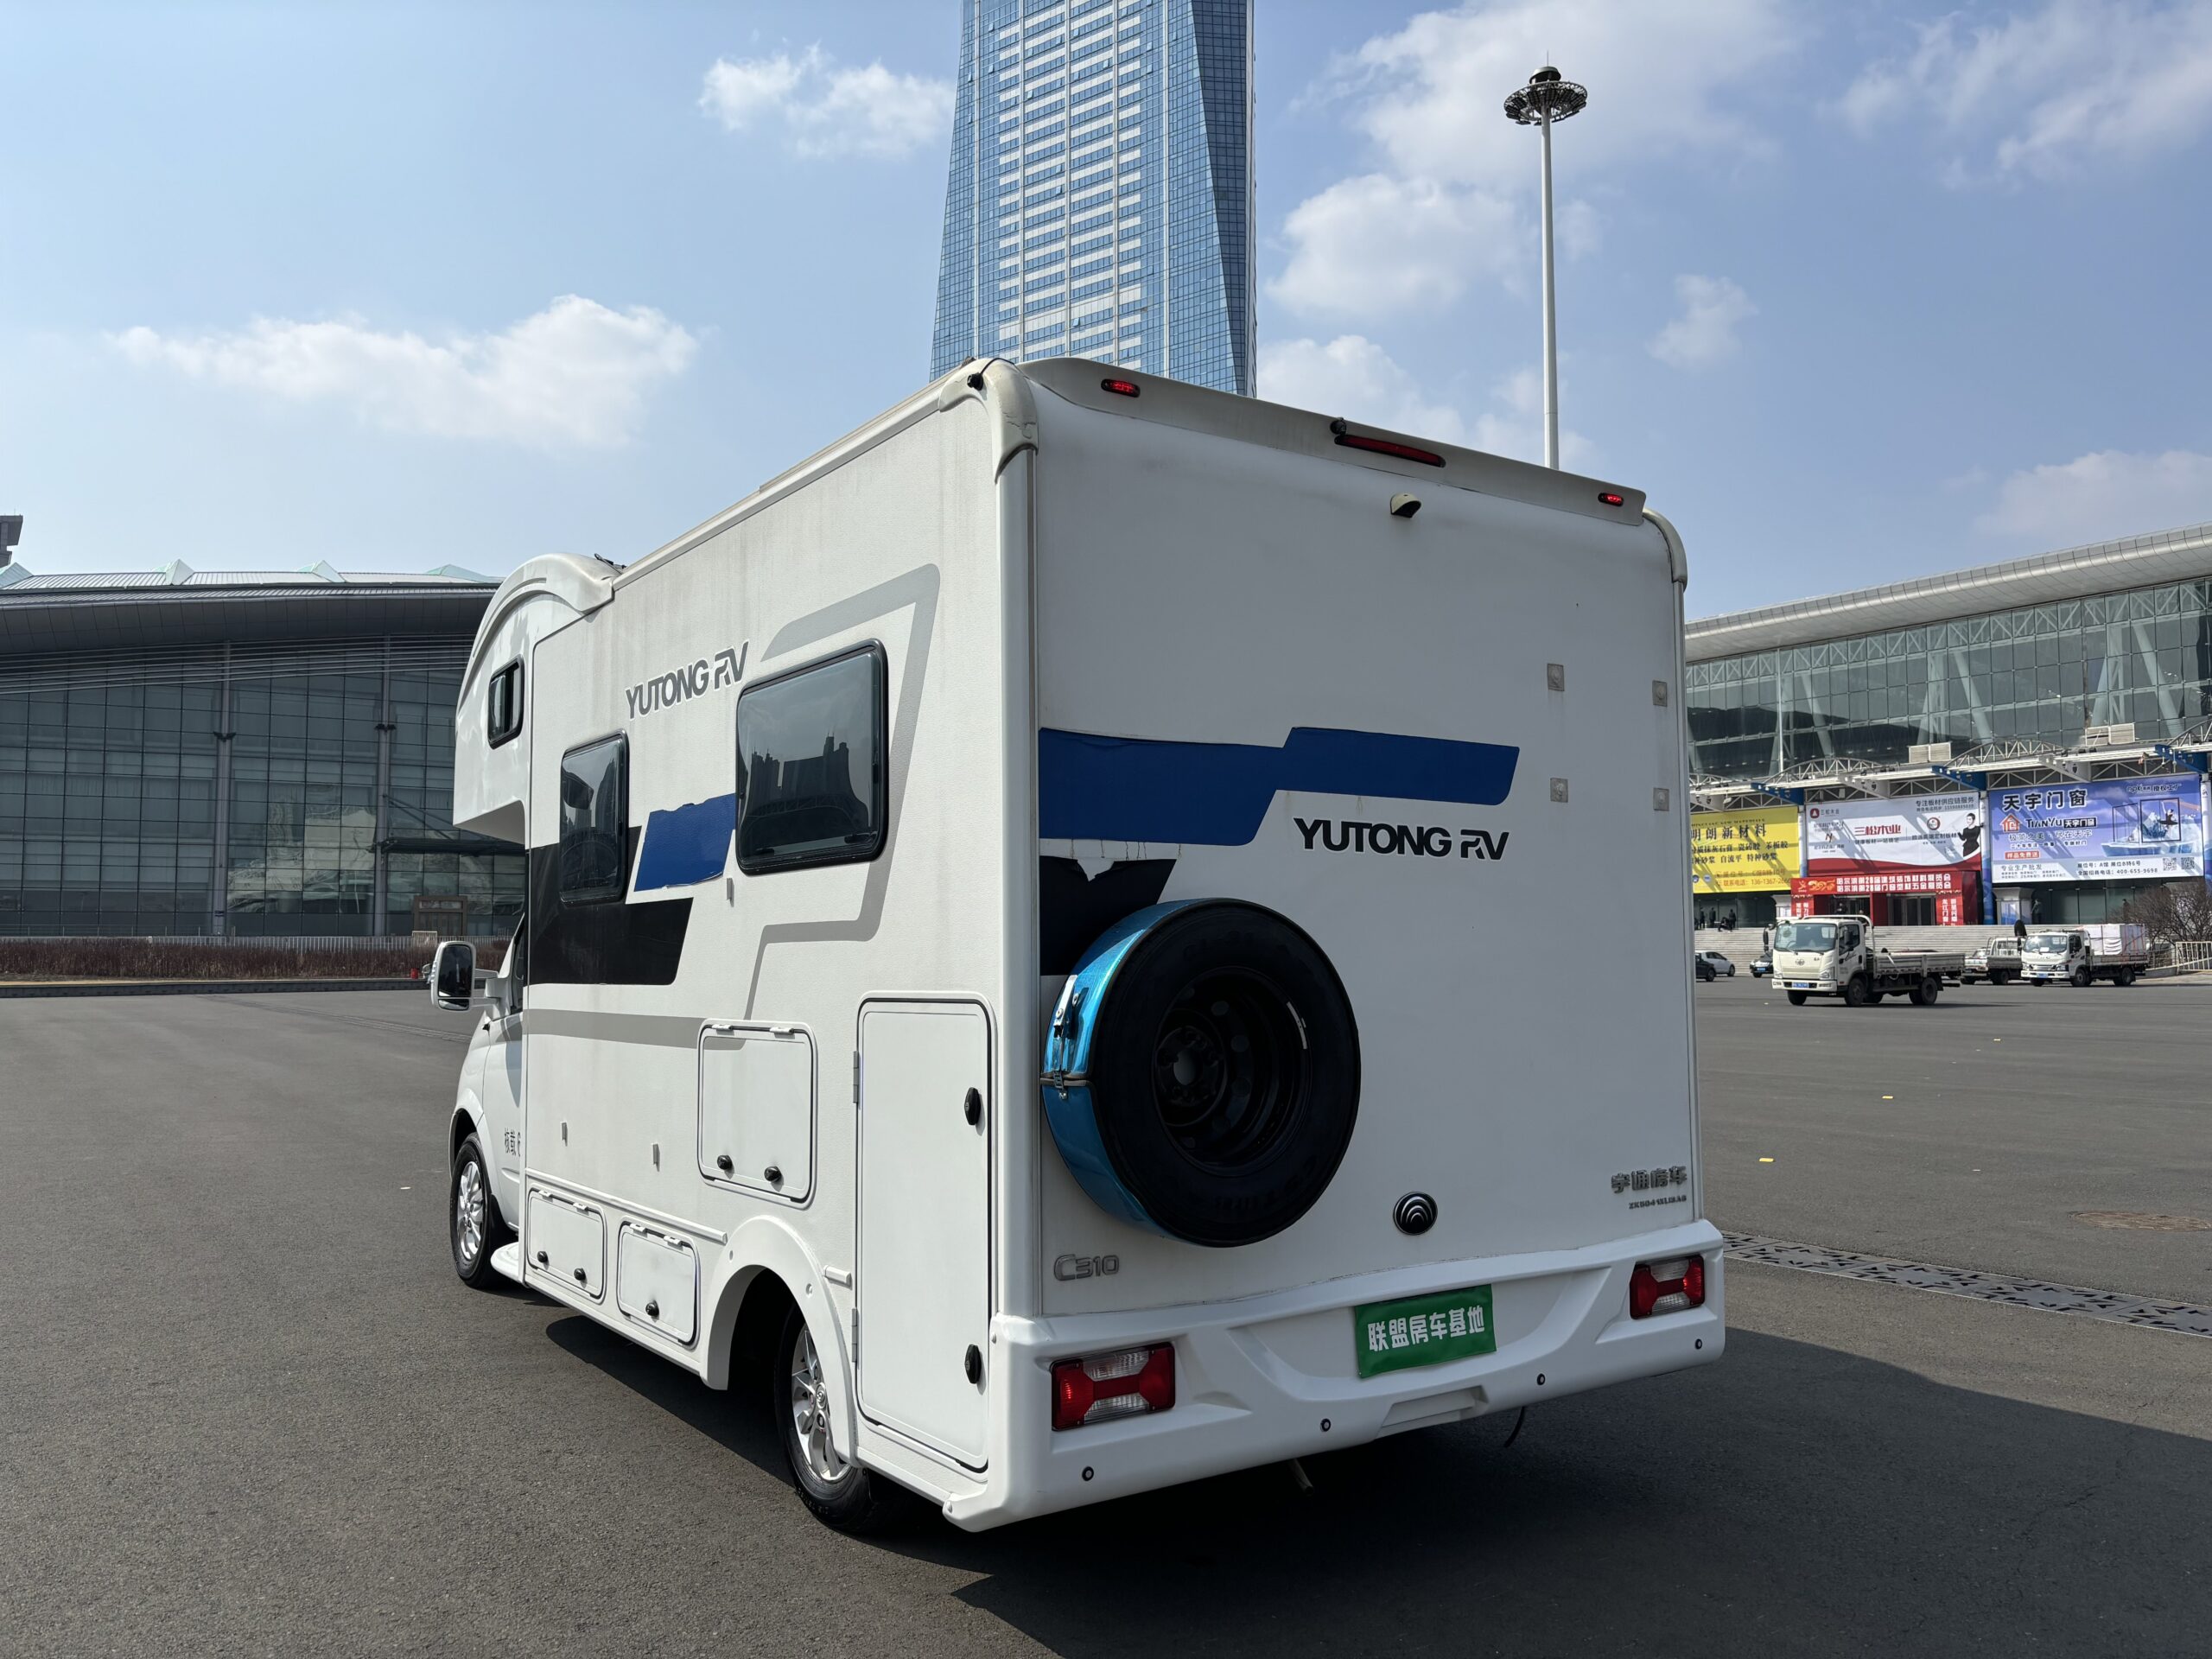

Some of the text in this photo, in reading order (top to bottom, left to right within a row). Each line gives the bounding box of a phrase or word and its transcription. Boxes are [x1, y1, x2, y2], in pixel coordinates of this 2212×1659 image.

[626, 641, 749, 719] YUTONG RV
[1916, 797, 1974, 807] 专注板材供应链服务
[2003, 790, 2087, 811] 天宇门窗
[1854, 823, 1902, 836] 三松木业
[2064, 818, 2095, 827] 天宇门窗
[1293, 817, 1510, 861] YUTONG RV
[1611, 1166, 1688, 1193] 宇通房车
[1054, 1254, 1119, 1281] C310
[1368, 1305, 1484, 1351] 联盟房车基地
